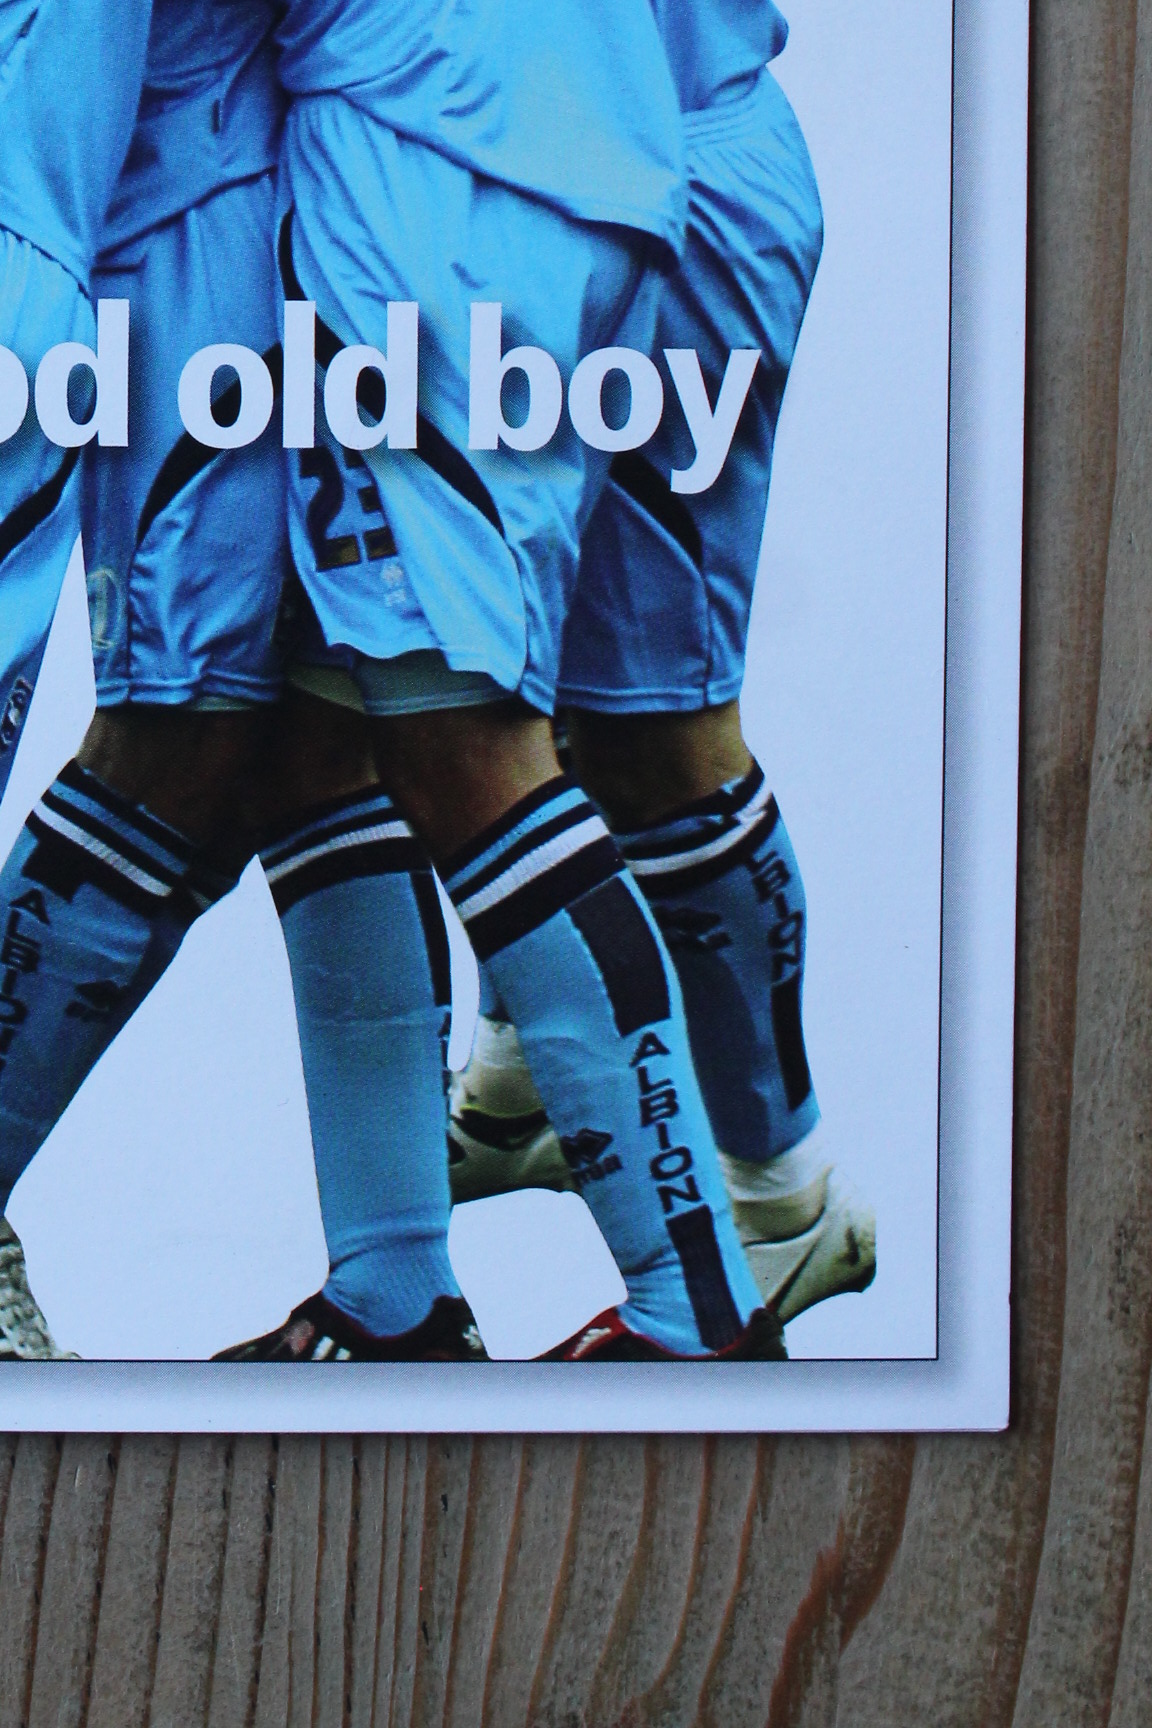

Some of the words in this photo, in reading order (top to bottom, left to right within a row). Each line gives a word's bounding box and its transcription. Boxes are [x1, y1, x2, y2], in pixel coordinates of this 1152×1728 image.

[177, 300, 419, 450] old
[468, 302, 761, 495] boy
[629, 1031, 702, 1213] ALBION
